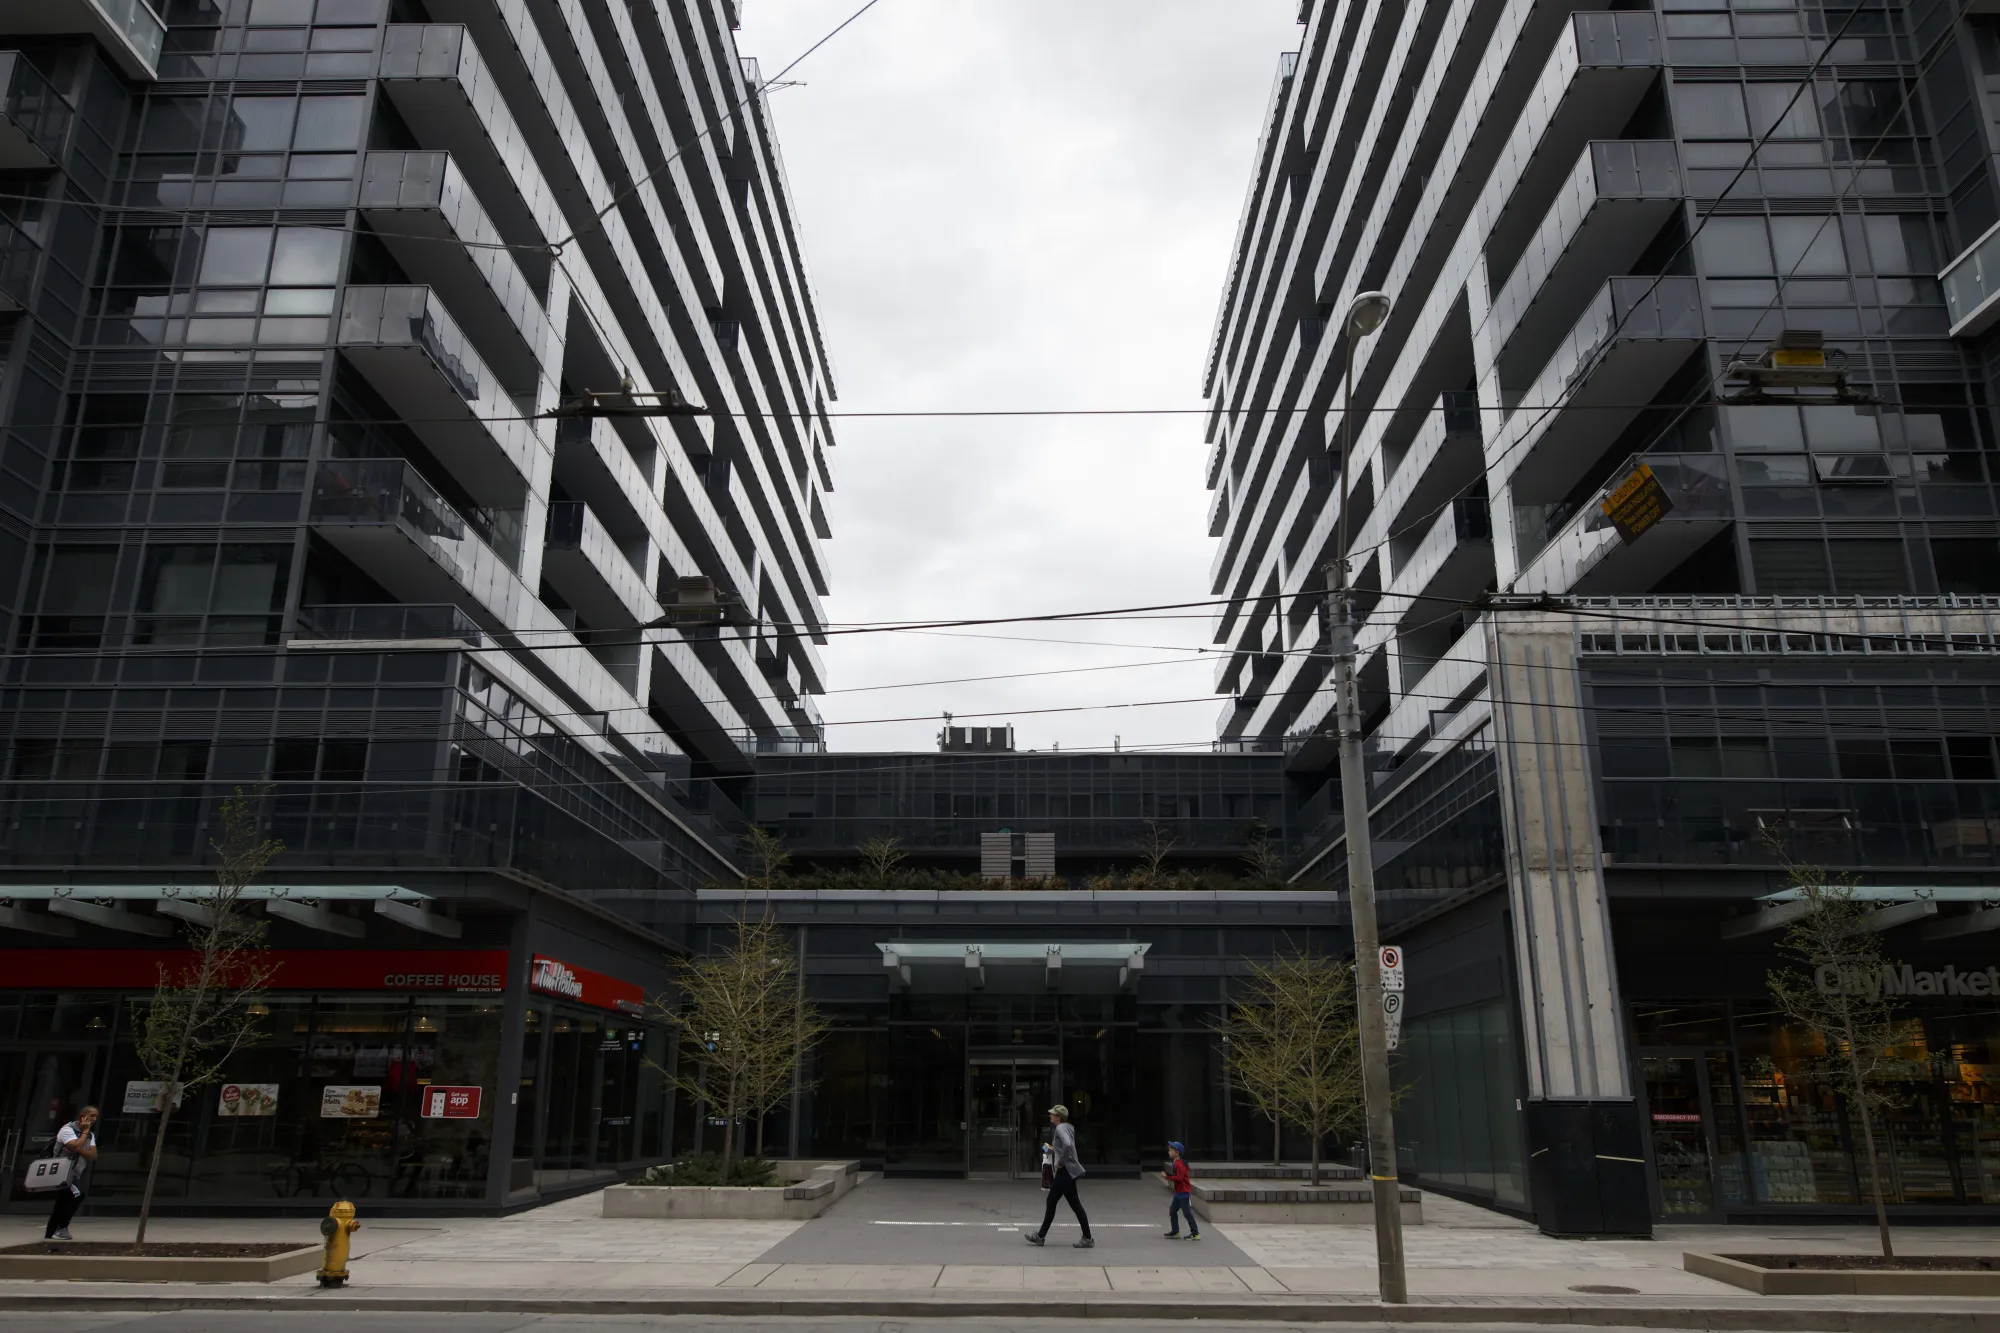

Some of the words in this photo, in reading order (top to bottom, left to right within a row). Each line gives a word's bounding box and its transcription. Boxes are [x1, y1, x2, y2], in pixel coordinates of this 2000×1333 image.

[1613, 475, 1640, 503] CAUTION
[384, 974, 445, 986] COFFEE
[447, 974, 501, 986] HOUSE
[450, 1097, 469, 1107] app
